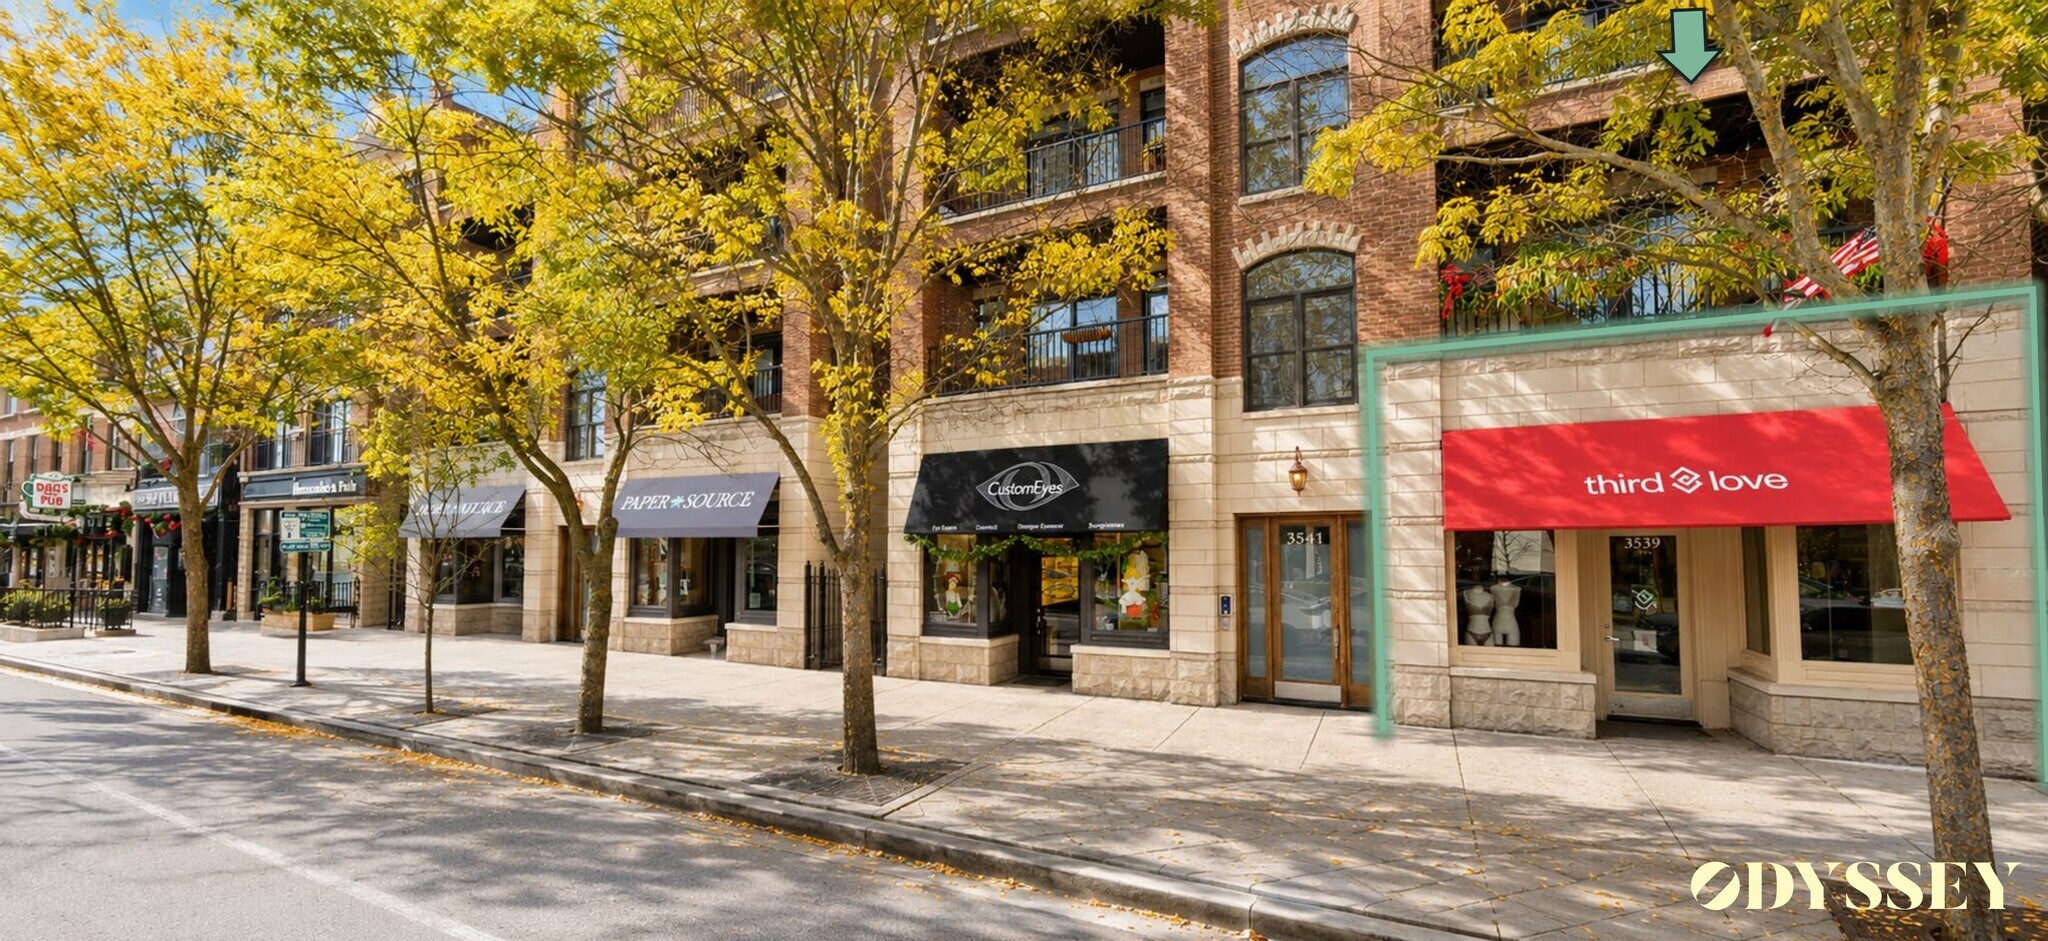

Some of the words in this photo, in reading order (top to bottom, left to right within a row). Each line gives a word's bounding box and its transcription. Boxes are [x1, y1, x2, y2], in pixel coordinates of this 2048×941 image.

[988, 480, 1064, 499] CustomEyes
[1584, 472, 1665, 495] third
[1708, 470, 1789, 491] love
[40, 496, 64, 506] PUB
[620, 494, 671, 511] PAPER
[682, 491, 755, 509] SOURCE
[1286, 532, 1323, 545] 3541
[1624, 537, 1661, 549] 3539
